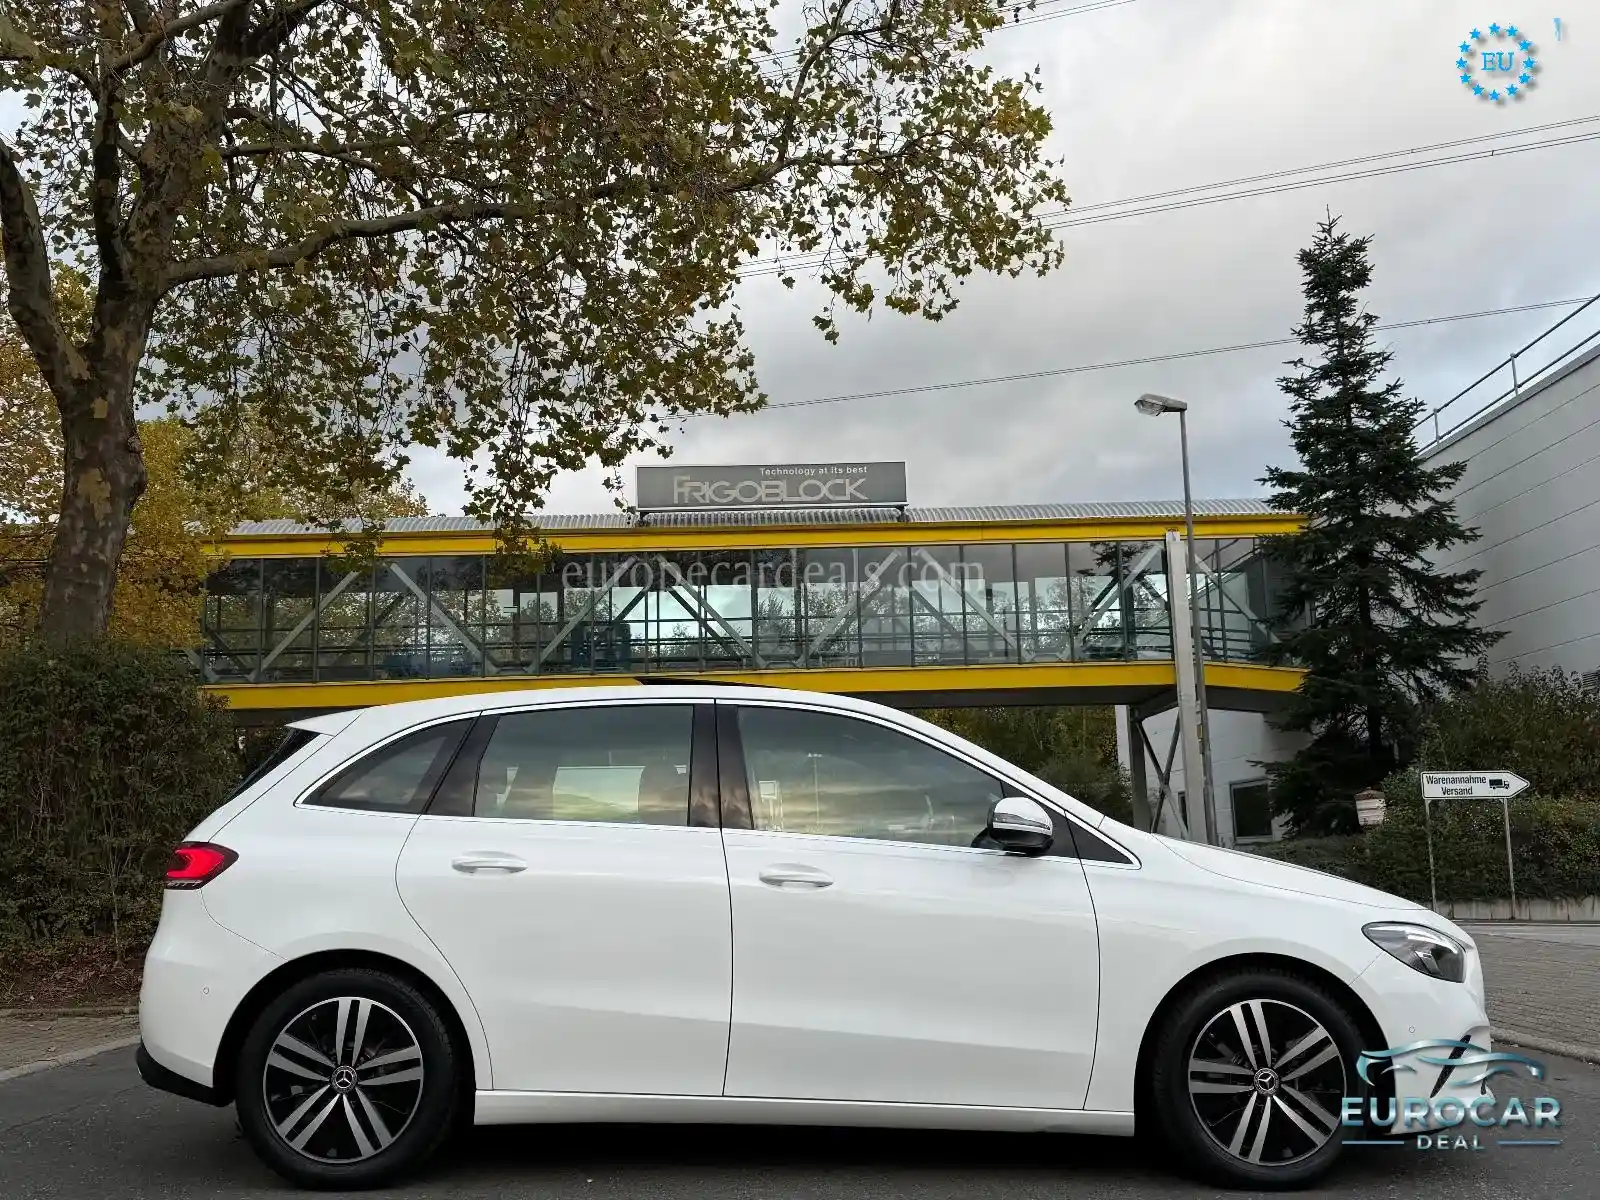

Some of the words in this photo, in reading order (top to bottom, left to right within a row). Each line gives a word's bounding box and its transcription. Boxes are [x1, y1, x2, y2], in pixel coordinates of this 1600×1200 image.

[760, 467, 815, 476] Technology
[831, 466, 843, 474] its
[846, 466, 868, 474] best
[674, 475, 869, 504] FRIGOBLOCK
[1426, 775, 1487, 785] Warenannahme
[1441, 786, 1473, 796] Versand
